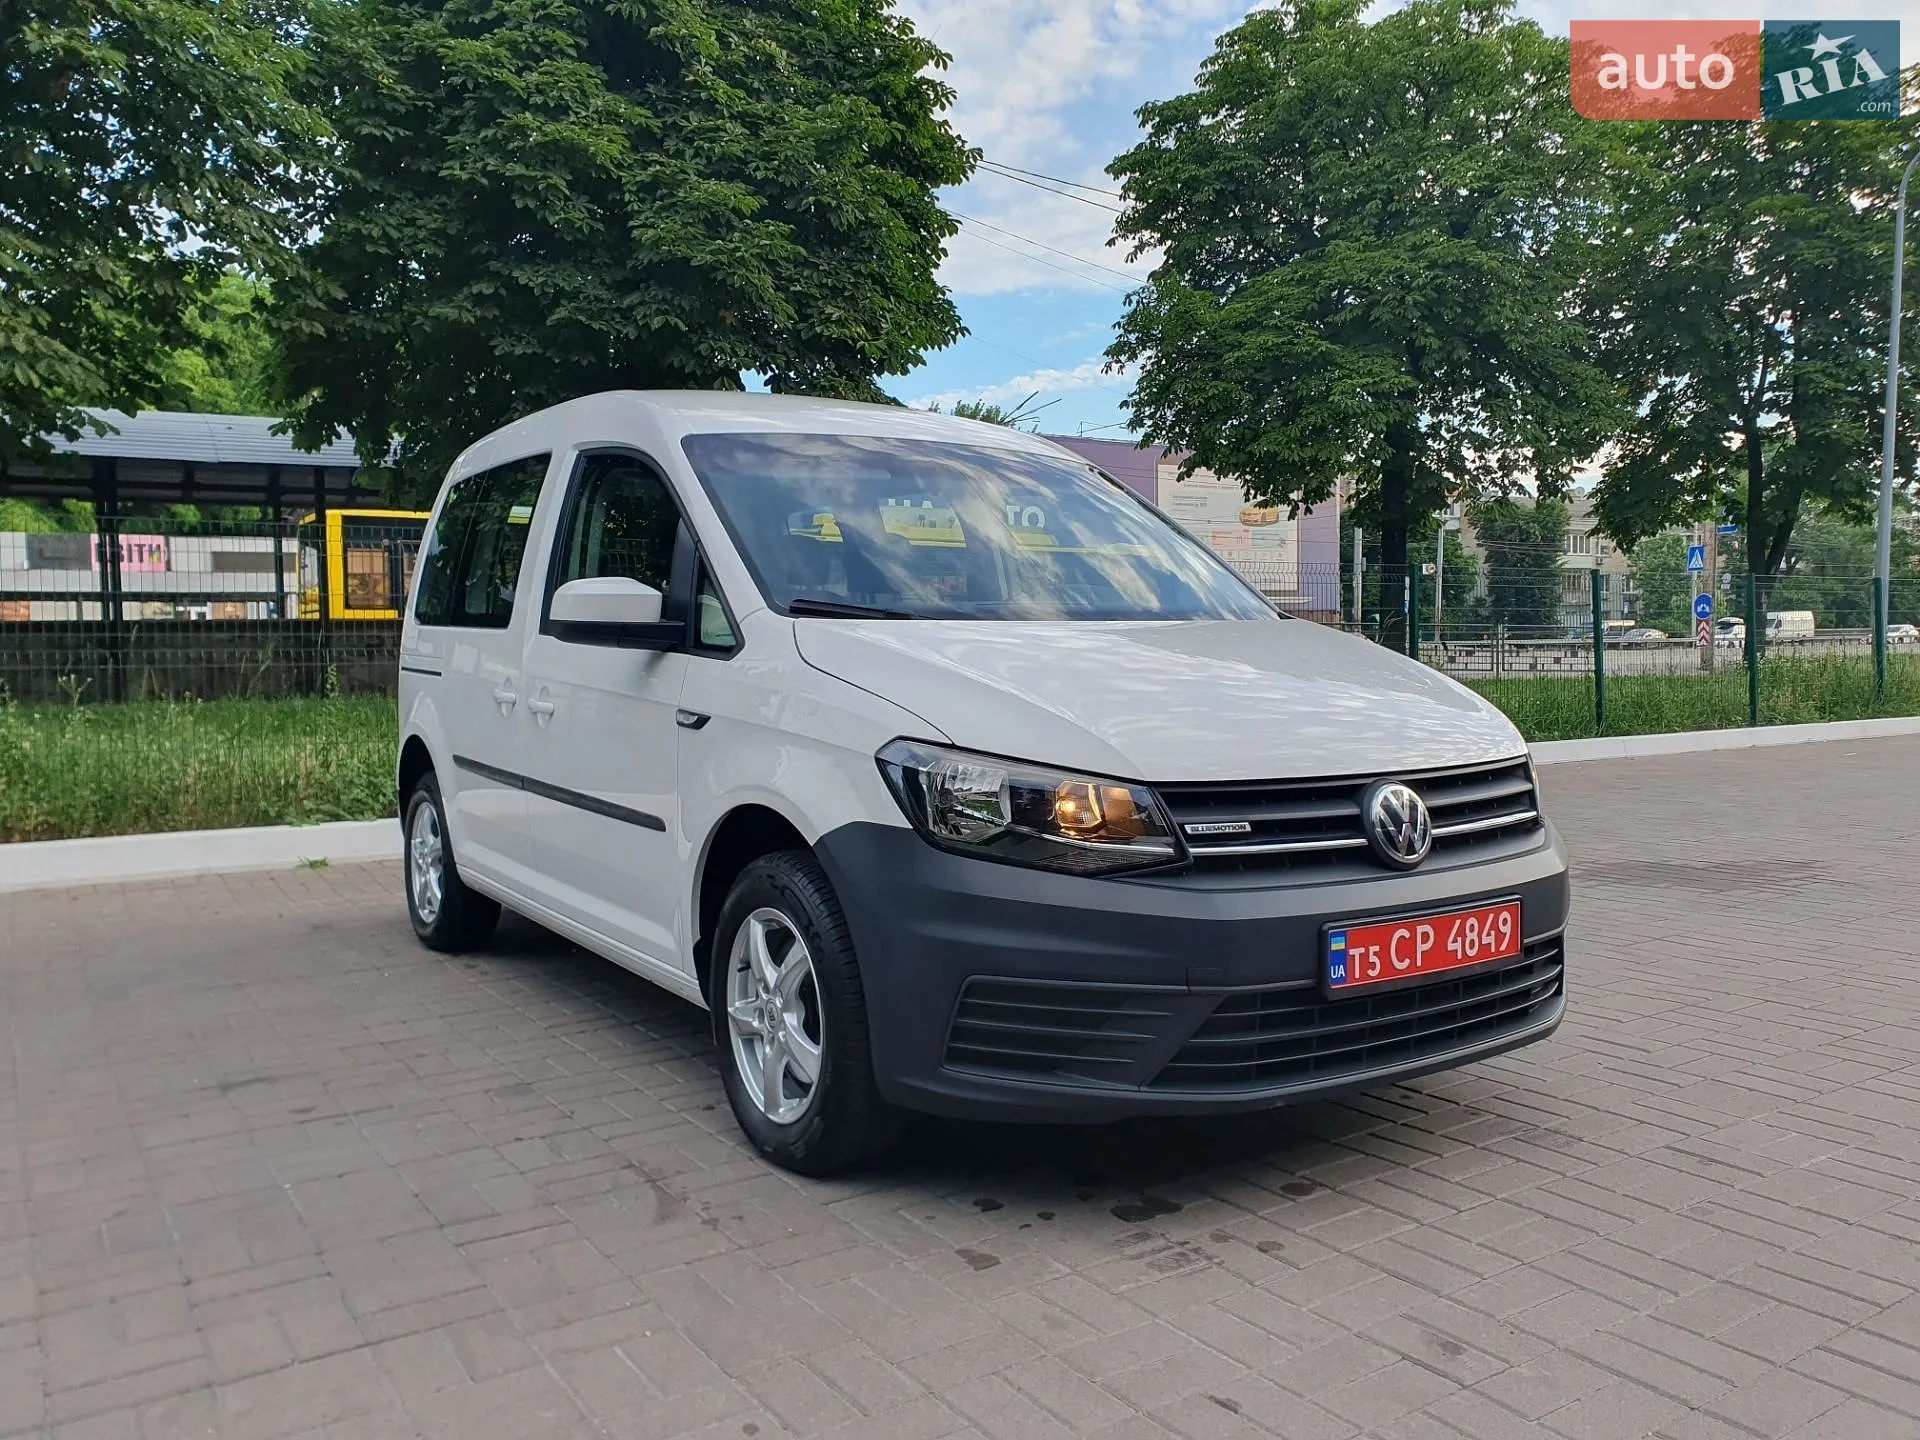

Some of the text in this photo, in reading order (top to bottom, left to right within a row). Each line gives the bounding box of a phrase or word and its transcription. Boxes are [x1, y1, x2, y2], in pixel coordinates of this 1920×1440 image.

[1349, 910, 1512, 979] T5 CP 4849
[1330, 964, 1346, 979] UA
